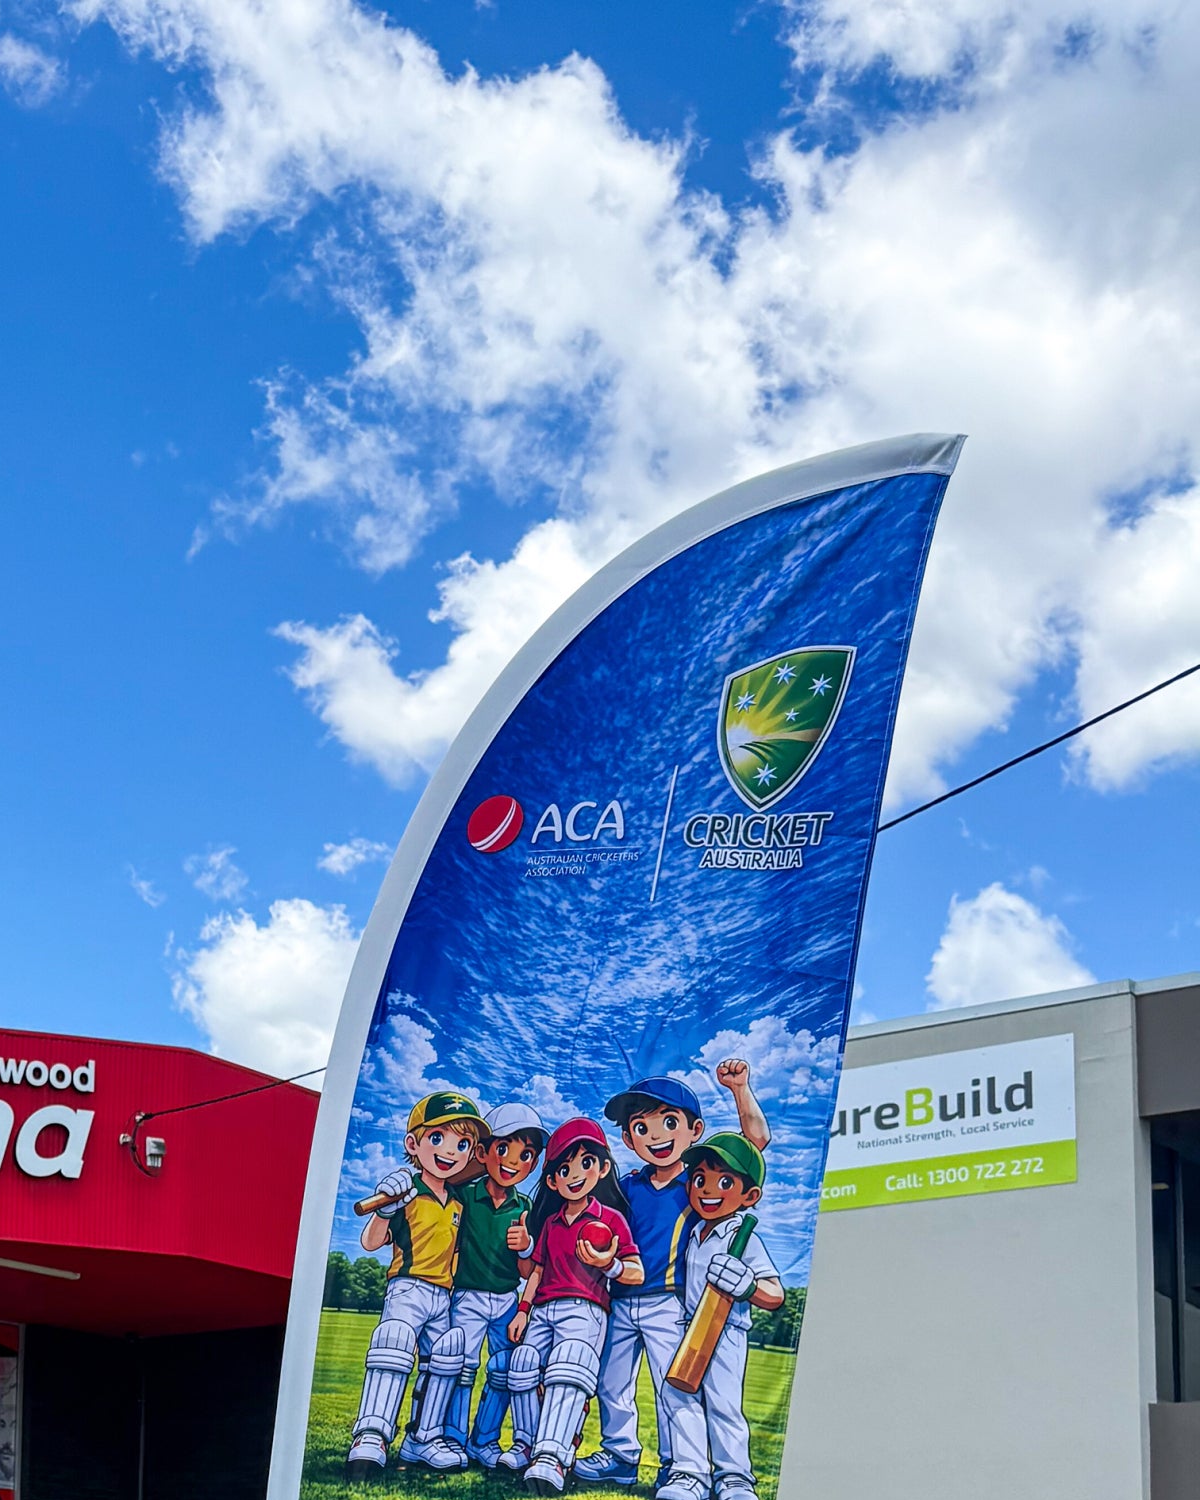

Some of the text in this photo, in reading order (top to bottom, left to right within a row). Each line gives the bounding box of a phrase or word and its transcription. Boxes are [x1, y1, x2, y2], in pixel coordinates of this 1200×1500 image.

[531, 799, 625, 845] ACA
[684, 811, 834, 848] CRICKET
[524, 865, 586, 878] ASSOCIATION
[527, 854, 583, 865] AUSTRALIAN
[699, 848, 802, 871] AUSTRALIA
[857, 1116, 1035, 1150] National Strength, Local Service
[885, 1174, 923, 1191] Call:
[927, 1166, 970, 1187] 1300
[974, 1161, 1006, 1181] 722
[1010, 1157, 1044, 1177] 272
